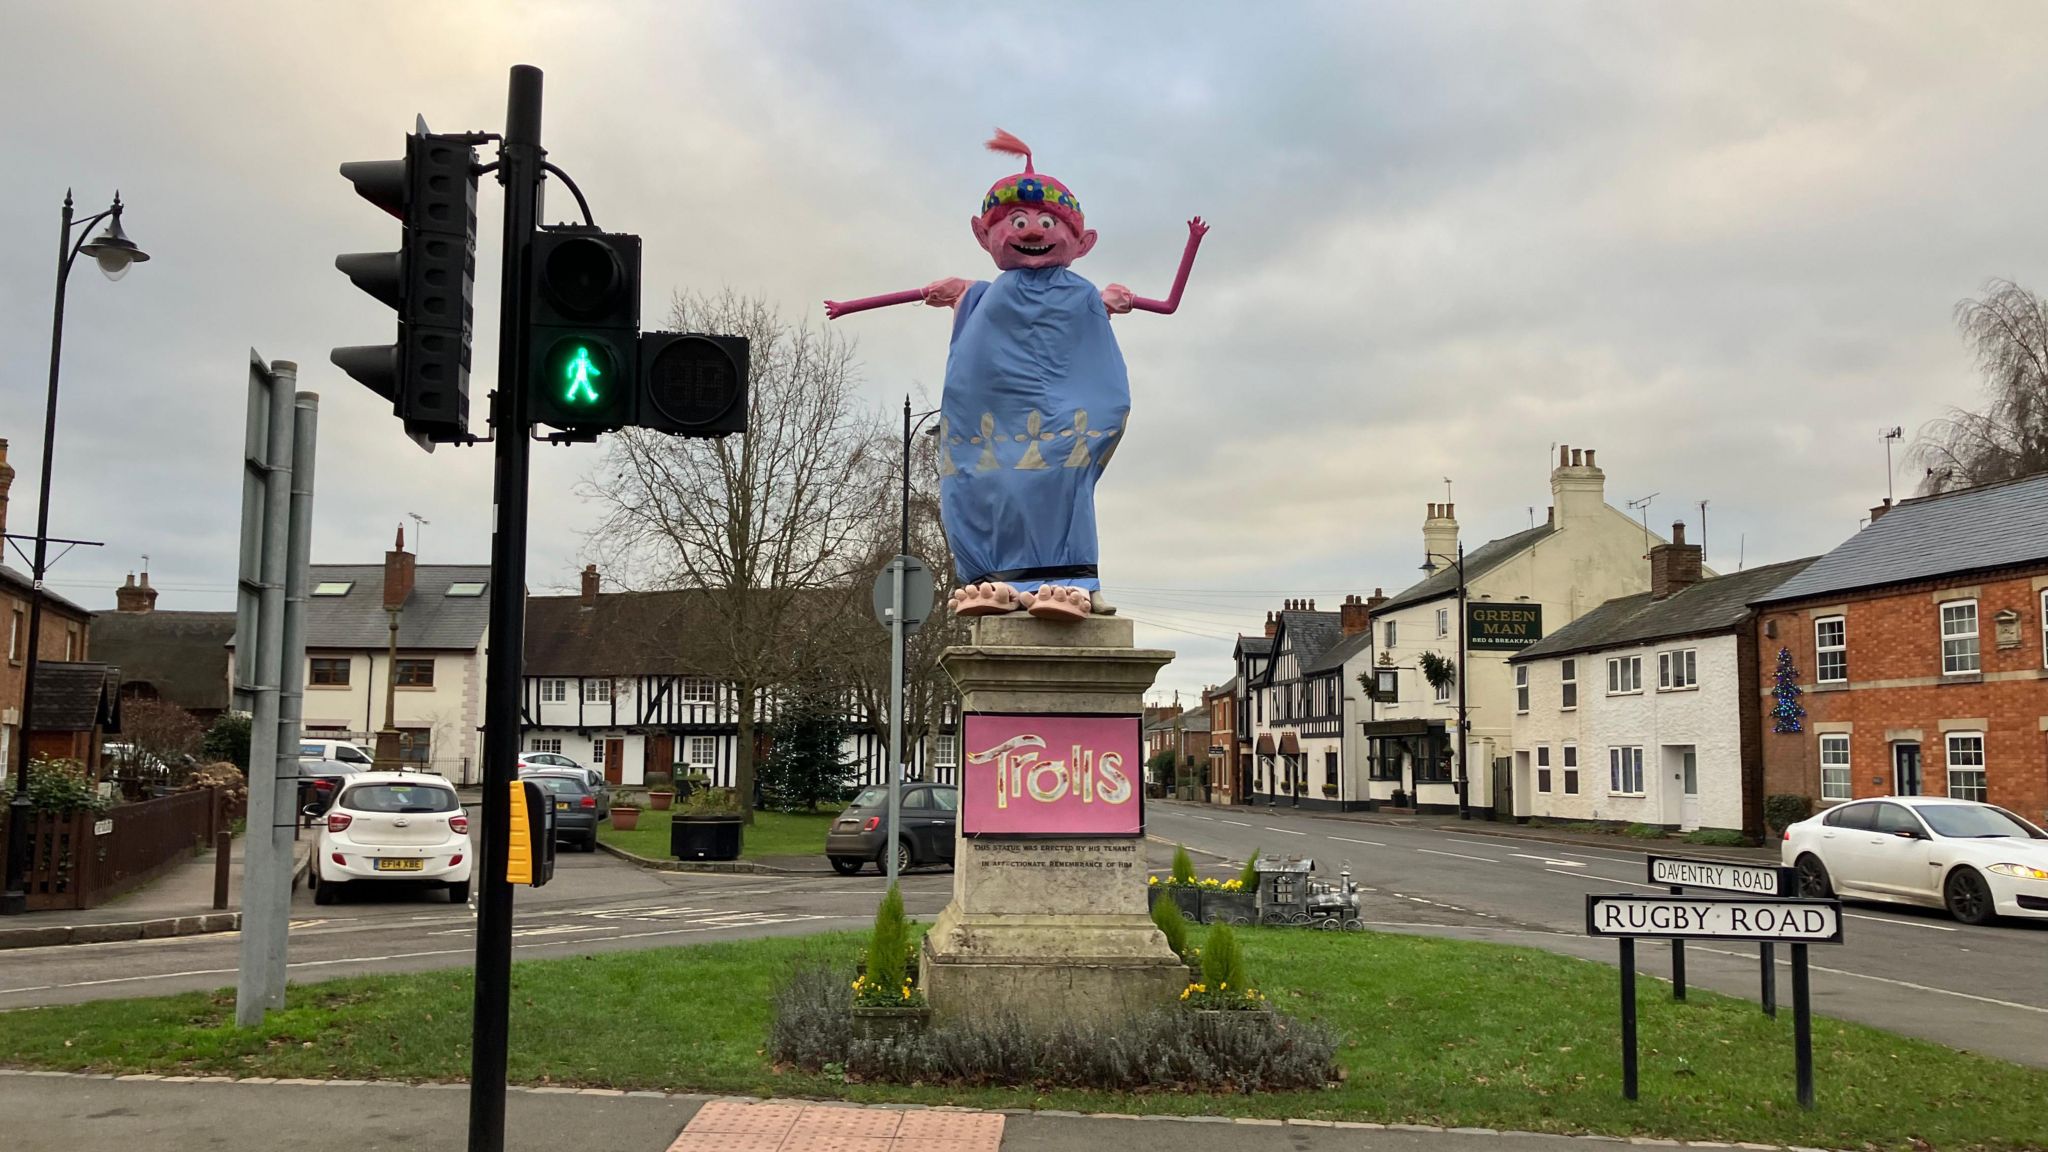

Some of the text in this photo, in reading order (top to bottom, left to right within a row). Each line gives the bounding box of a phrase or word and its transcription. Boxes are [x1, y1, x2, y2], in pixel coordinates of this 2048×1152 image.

[1473, 609, 1537, 622] GREEN
[1483, 623, 1527, 635] MAN
[967, 734, 1132, 809] Trolls
[1658, 862, 1774, 891] DAVENTRY ROAD
[1605, 904, 1825, 933] RUGBY ROAD
